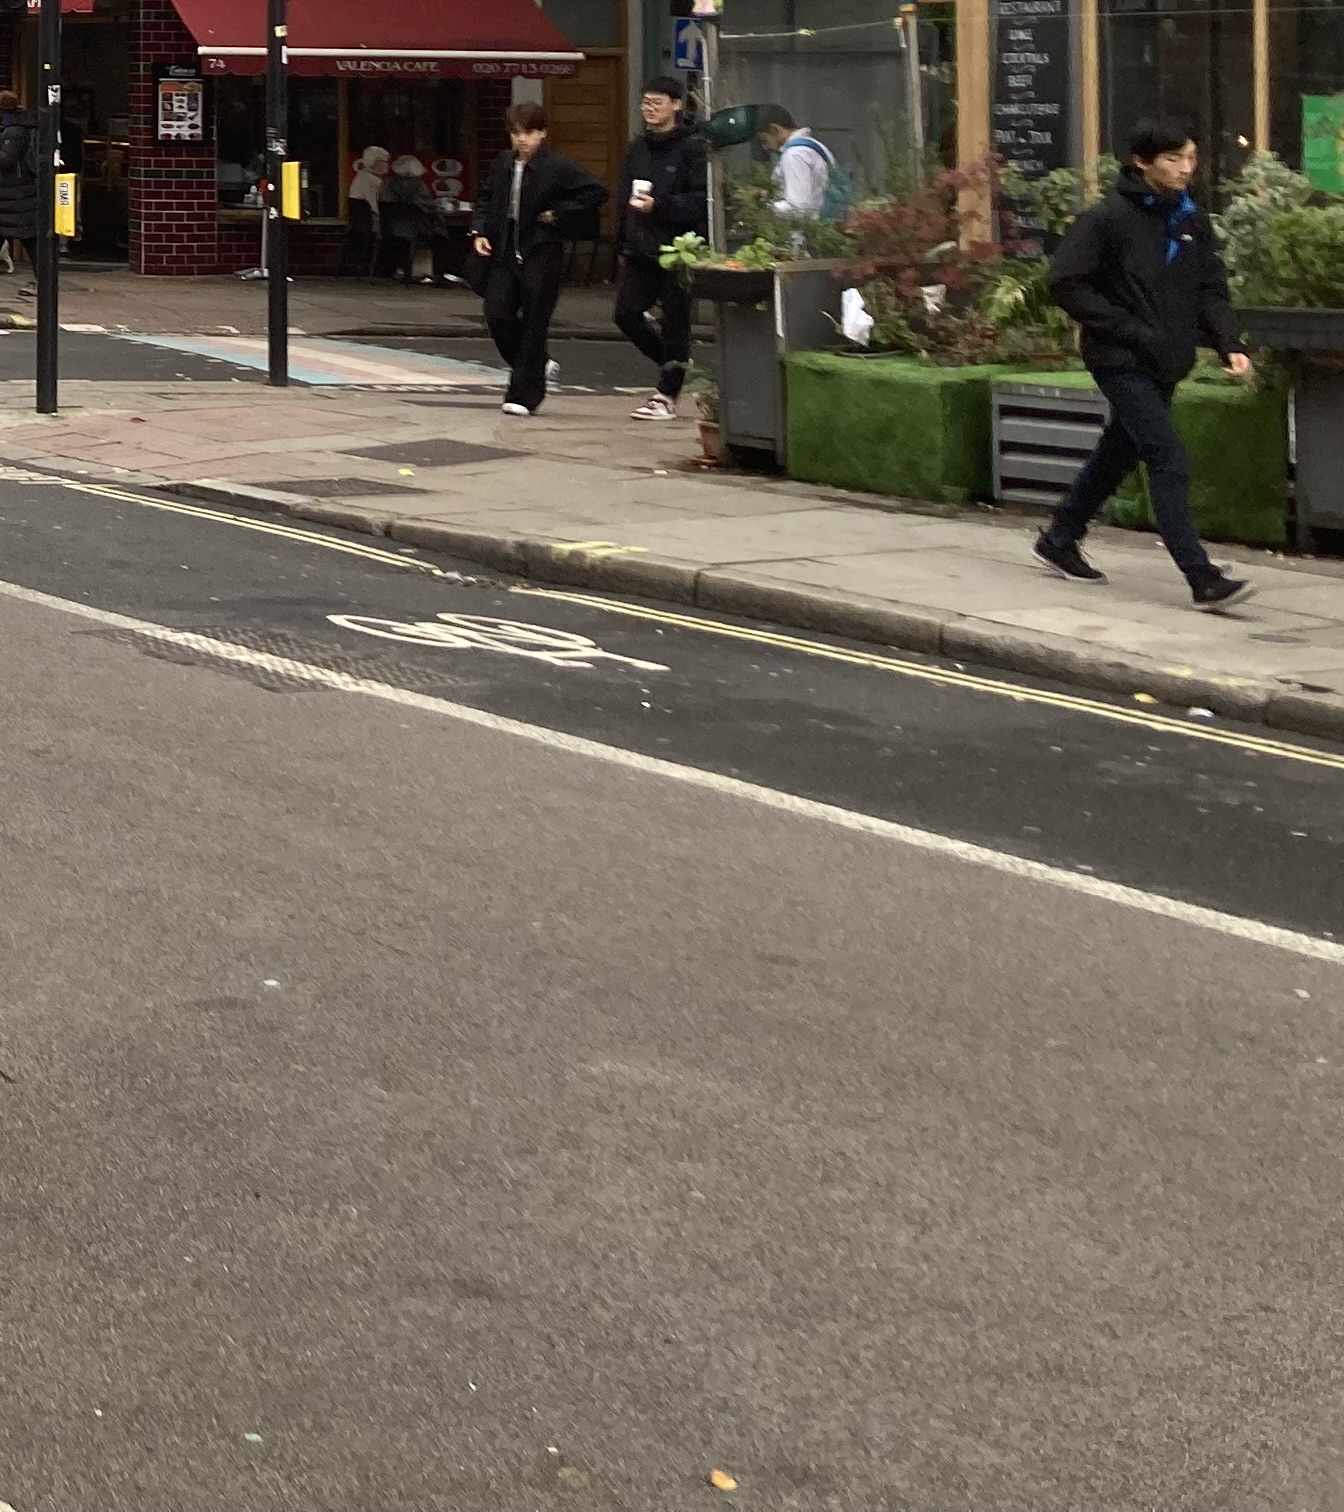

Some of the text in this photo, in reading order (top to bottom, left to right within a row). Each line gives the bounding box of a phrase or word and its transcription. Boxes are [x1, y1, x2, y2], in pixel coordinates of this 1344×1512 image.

[207, 58, 226, 69] 74
[335, 60, 403, 72] VALENCIA
[403, 61, 441, 72] CAFE
